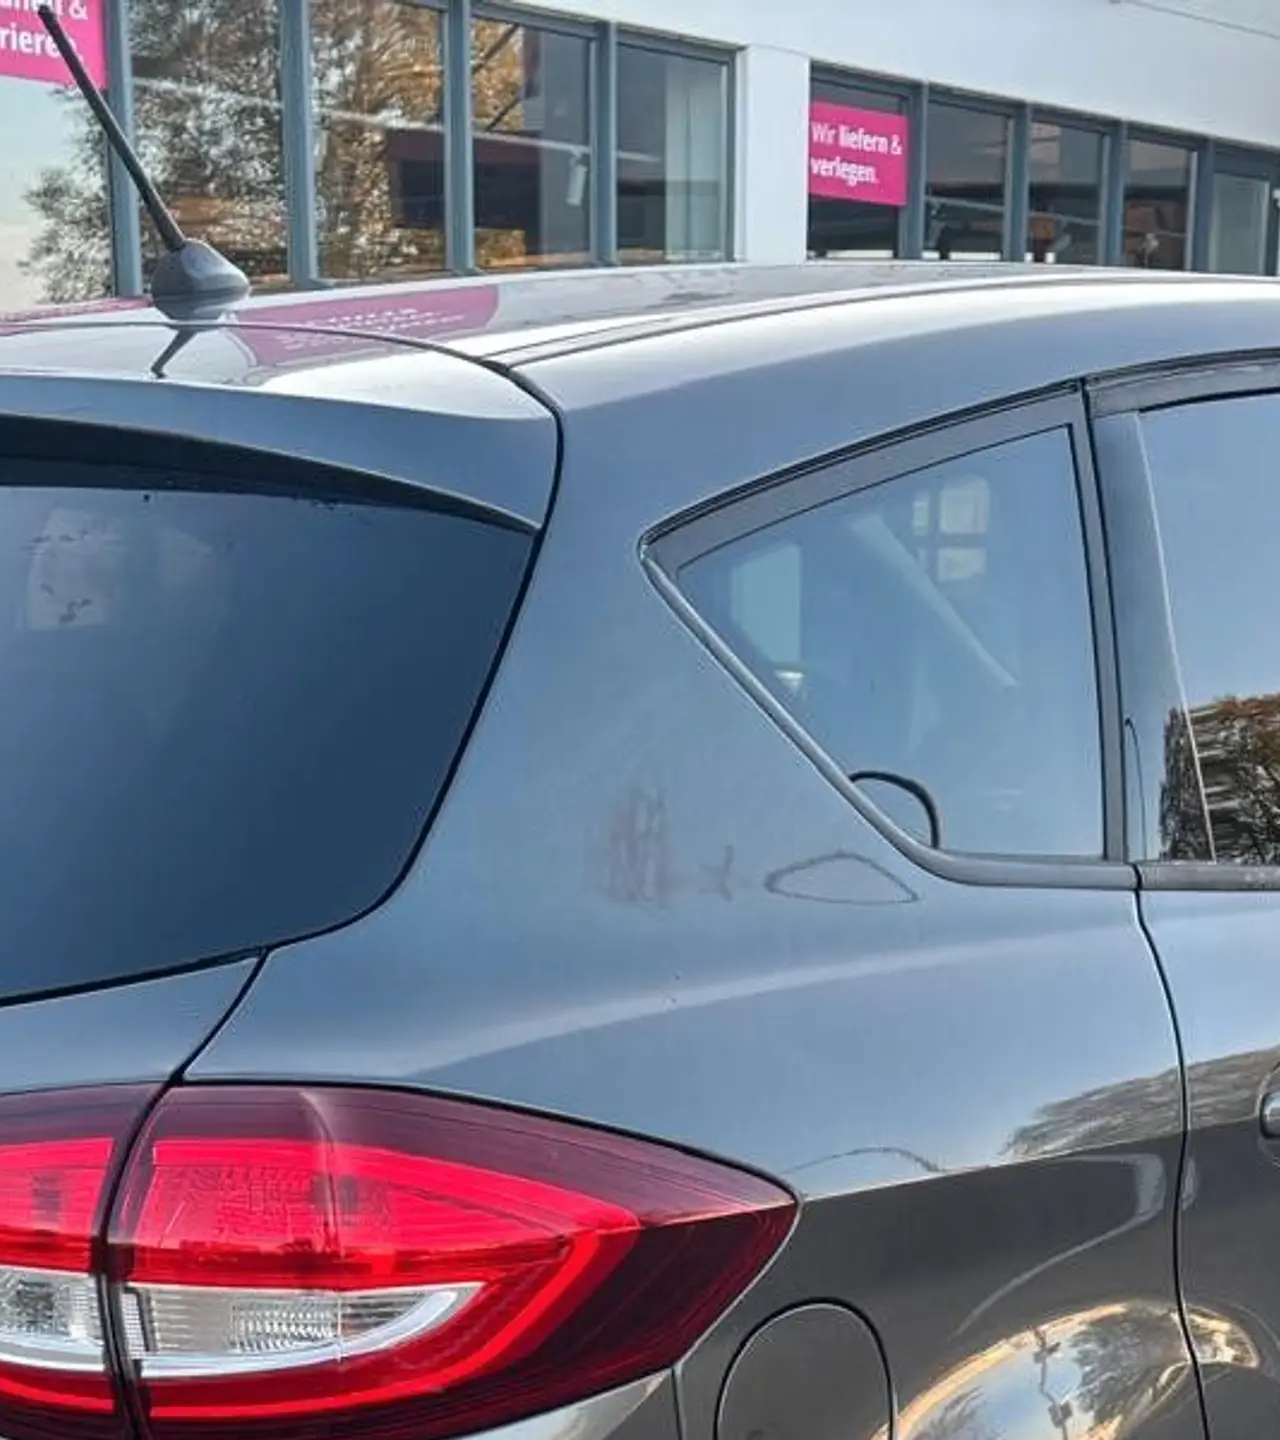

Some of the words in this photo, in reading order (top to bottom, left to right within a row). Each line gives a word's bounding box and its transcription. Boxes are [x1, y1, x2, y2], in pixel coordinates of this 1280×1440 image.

[68, 0, 88, 20] &
[811, 121, 836, 145] Wir
[838, 125, 888, 155] liefern
[890, 133, 902, 155] &
[811, 156, 880, 187] verlegen.
